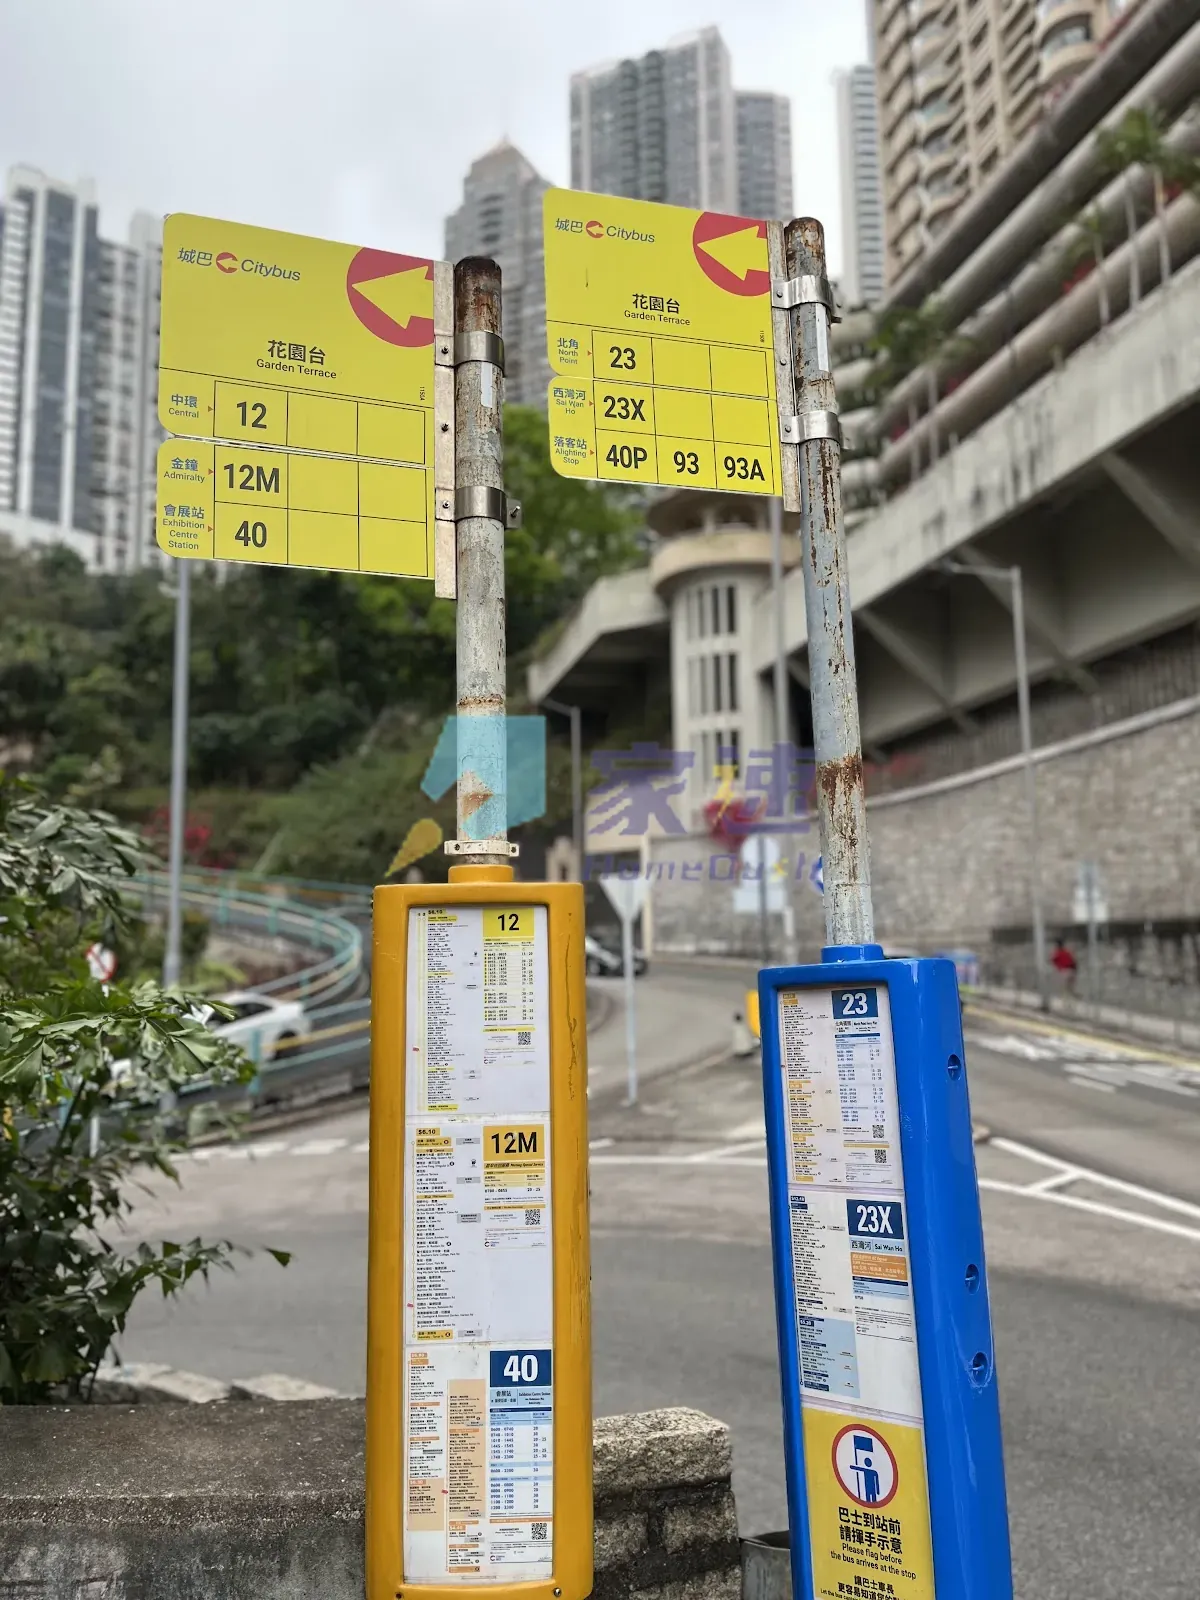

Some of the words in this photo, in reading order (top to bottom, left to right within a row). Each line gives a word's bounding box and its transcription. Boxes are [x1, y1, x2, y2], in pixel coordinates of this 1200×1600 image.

[555, 218, 583, 233] 城巴
[606, 225, 655, 244] Citybus
[177, 247, 212, 266] 城巴
[240, 259, 300, 281] Citybus
[632, 293, 680, 315] 花園台
[624, 310, 655, 322] Garden
[657, 313, 690, 326] Terrace
[557, 337, 579, 349] 北角
[267, 340, 326, 366] 花園台
[558, 349, 578, 357] North
[559, 356, 578, 364] Point
[609, 346, 636, 370] 23
[256, 358, 295, 373] Garden
[297, 364, 337, 379] Terrace
[171, 394, 198, 408] 中環
[553, 387, 586, 401] 西灣河
[556, 399, 568, 407] Sai
[569, 400, 584, 408] Wan
[565, 407, 576, 415] Ho
[603, 395, 646, 422] 23X
[168, 407, 199, 419] Central
[236, 401, 267, 429] 12
[554, 436, 587, 450] 落客站
[555, 448, 587, 458] Alighting
[563, 456, 579, 465] Stop
[171, 457, 198, 472] 金鐘
[606, 444, 648, 469] 40P
[673, 451, 700, 475] 93
[723, 455, 765, 482] 93A
[163, 471, 205, 483] Admiralty
[223, 463, 280, 494] 12M
[163, 503, 205, 519] 會展站
[162, 518, 205, 529] Exhibition
[169, 529, 198, 539] Centre
[234, 520, 267, 548] 40
[168, 540, 199, 550] Station
[497, 913, 520, 931] 12
[841, 992, 868, 1015] 23
[491, 1132, 537, 1154] 12M
[856, 1204, 894, 1235] 23X
[851, 1240, 872, 1251] 西灣河
[503, 1354, 539, 1382] 40
[838, 1506, 901, 1536] 巴士到站前
[838, 1524, 903, 1555] 請揮手示意
[842, 1542, 864, 1556] Please
[865, 1548, 879, 1561] flag
[880, 1551, 902, 1565] before
[830, 1550, 841, 1560] the
[843, 1553, 855, 1564] bus
[856, 1558, 879, 1570] arrives
[880, 1563, 887, 1572] at
[888, 1565, 900, 1575] the
[901, 1569, 917, 1580] stop
